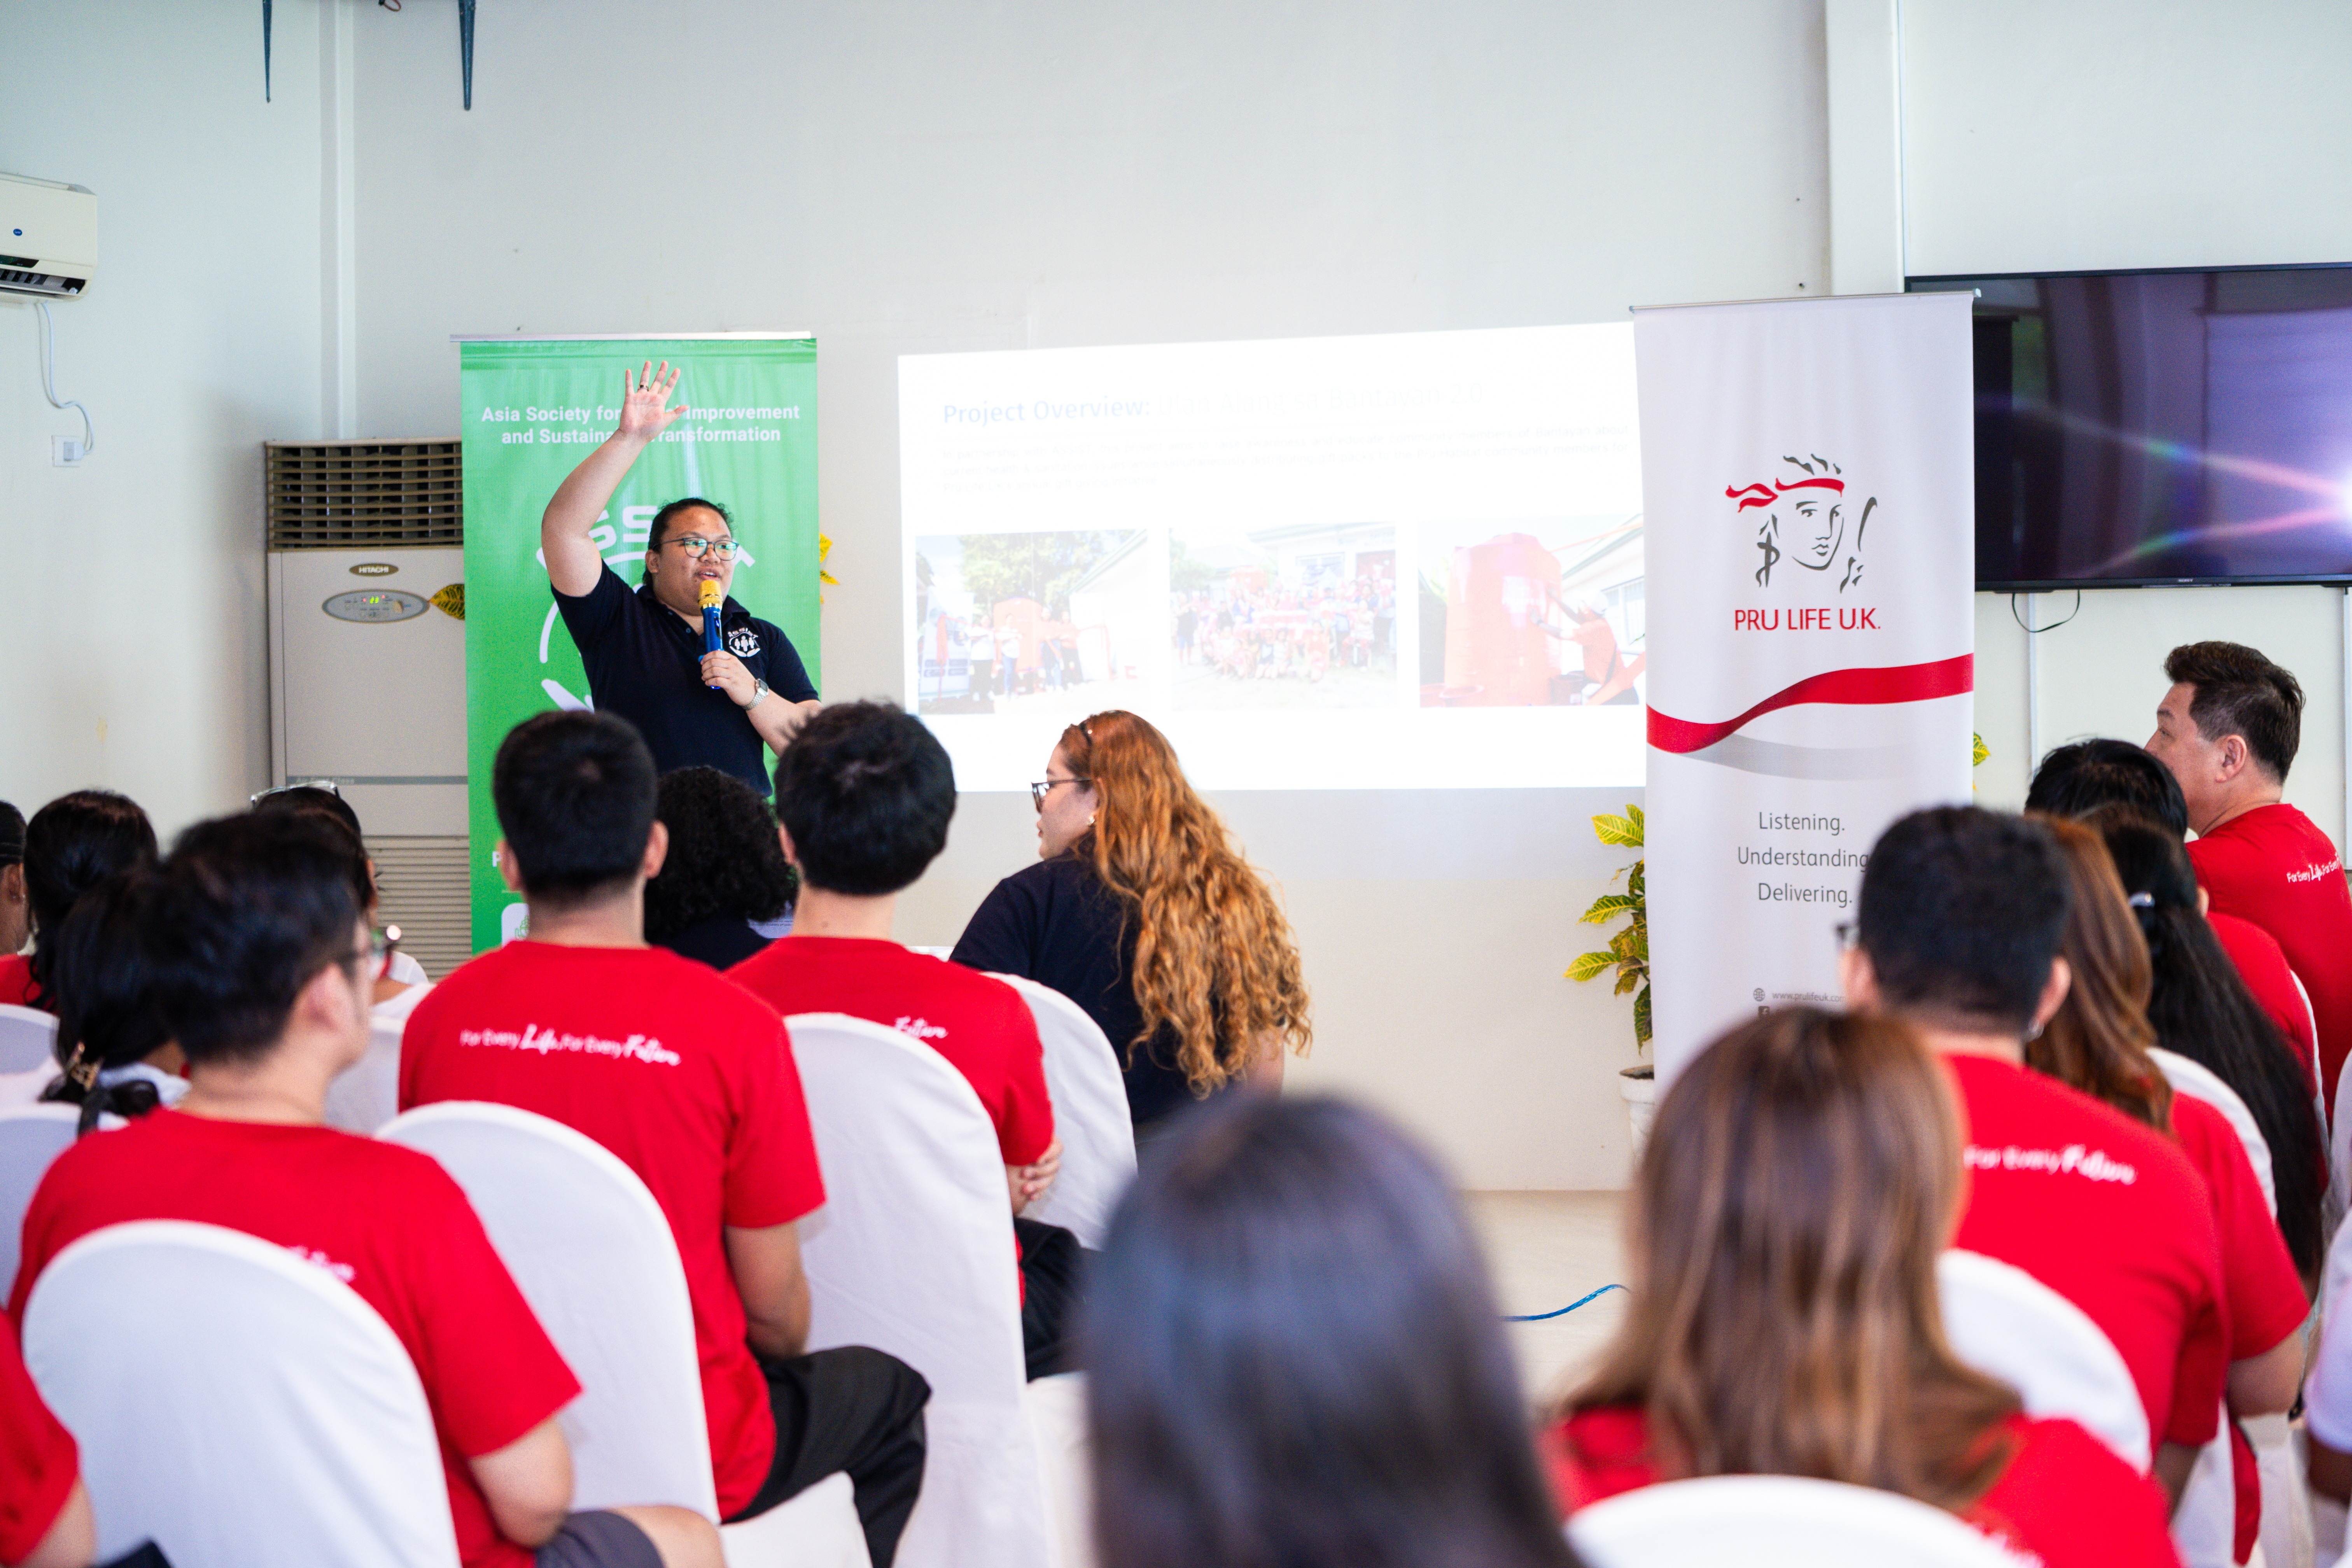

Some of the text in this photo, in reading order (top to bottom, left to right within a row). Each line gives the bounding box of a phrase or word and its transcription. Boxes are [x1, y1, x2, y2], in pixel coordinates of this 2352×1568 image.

[482, 406, 520, 422] Asia
[526, 406, 591, 425] Society
[597, 405, 622, 421] for
[943, 381, 1484, 427] Project Overview: Ulan Alang sa Bantayan 2.0
[502, 428, 534, 444] and
[652, 427, 780, 443] ransformation
[1734, 607, 1881, 631] PRU LIFE U.K.
[1759, 812, 1845, 836] Listening.
[2287, 872, 2297, 883] For
[1758, 883, 1852, 908] Delivering.
